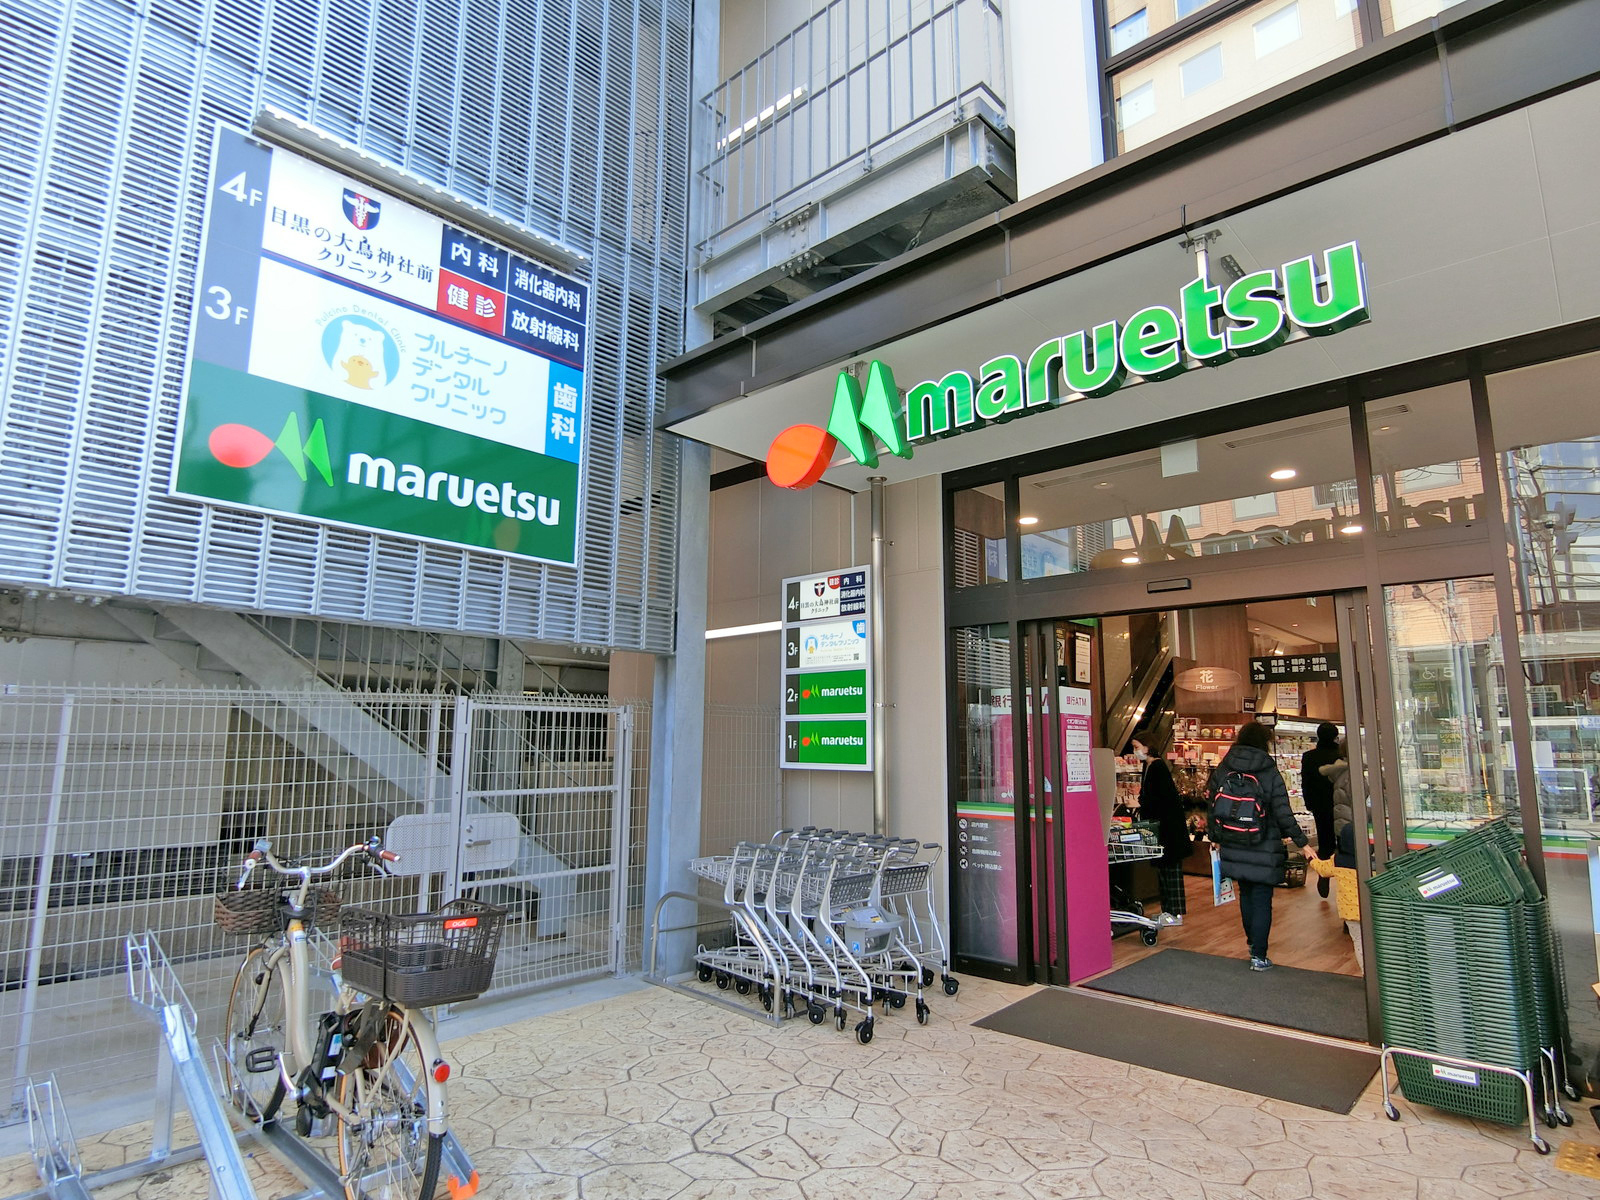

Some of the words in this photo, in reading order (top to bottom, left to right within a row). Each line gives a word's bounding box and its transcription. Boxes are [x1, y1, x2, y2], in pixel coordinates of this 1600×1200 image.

[219, 171, 263, 207] 4F
[271, 206, 433, 283] 目黒の大鳥神社前
[451, 242, 499, 278] 内科
[317, 247, 393, 284] クリニック
[205, 285, 249, 325] 3F
[447, 283, 497, 318] 健診
[515, 267, 581, 312] 消化器内科
[353, 304, 388, 326] Dental
[390, 327, 407, 353] Clinic
[511, 309, 579, 352] 放射線科
[906, 240, 1367, 444] maruetsu
[414, 331, 508, 376] プルチーノ
[411, 356, 490, 396] デンタル
[550, 381, 578, 444] 歯科
[347, 451, 561, 527] maruetsu
[843, 575, 863, 586] 内科
[788, 596, 799, 610] 4F
[788, 642, 798, 656] 3F
[821, 686, 863, 697] maruetsu
[1200, 669, 1214, 684] 花
[787, 688, 798, 702] 2F
[1066, 695, 1087, 706] 銀行ATM
[788, 735, 797, 749] 1F
[821, 735, 863, 746] maruetsu
